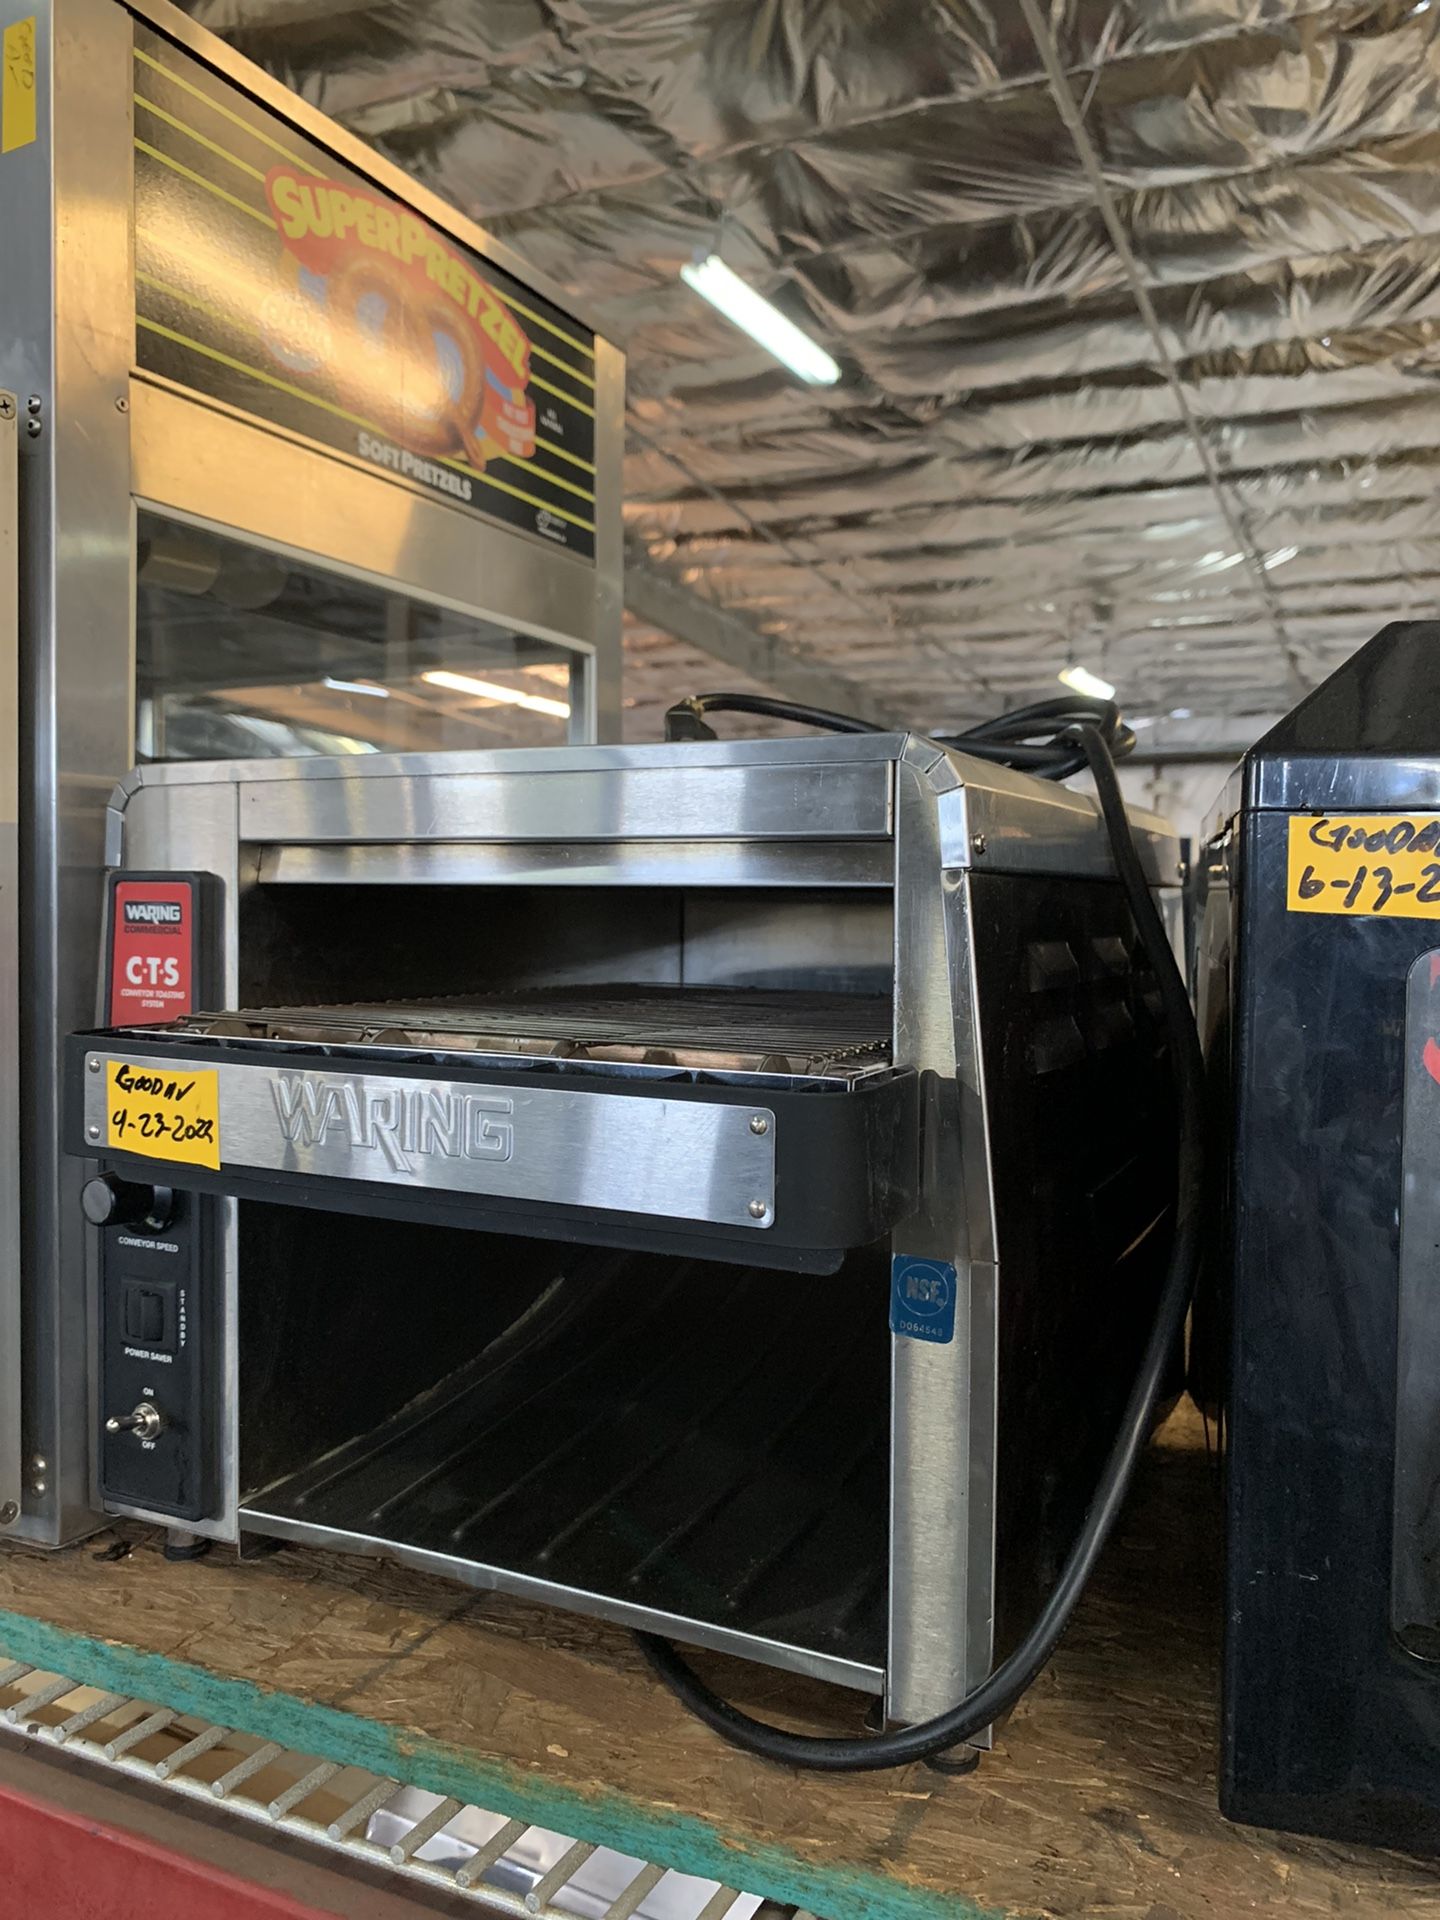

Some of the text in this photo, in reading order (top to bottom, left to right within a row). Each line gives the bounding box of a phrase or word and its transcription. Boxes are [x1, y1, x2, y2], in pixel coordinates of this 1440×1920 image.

[271, 175, 528, 378] SUPERPRETZEL
[357, 431, 472, 501] SOFT PRETZELS
[125, 904, 181, 925] WARING
[124, 926, 182, 935] COMMERCIAL
[115, 1064, 163, 1095] GOOD
[270, 1074, 514, 1173] WARING
[118, 1236, 179, 1253] CONVEYOR SPEED
[906, 1275, 942, 1303] NSF
[179, 1289, 187, 1347] STANDBY
[124, 1347, 173, 1364] POWER SAVER
[142, 1387, 154, 1397] ON
[141, 1440, 156, 1450] OFF
